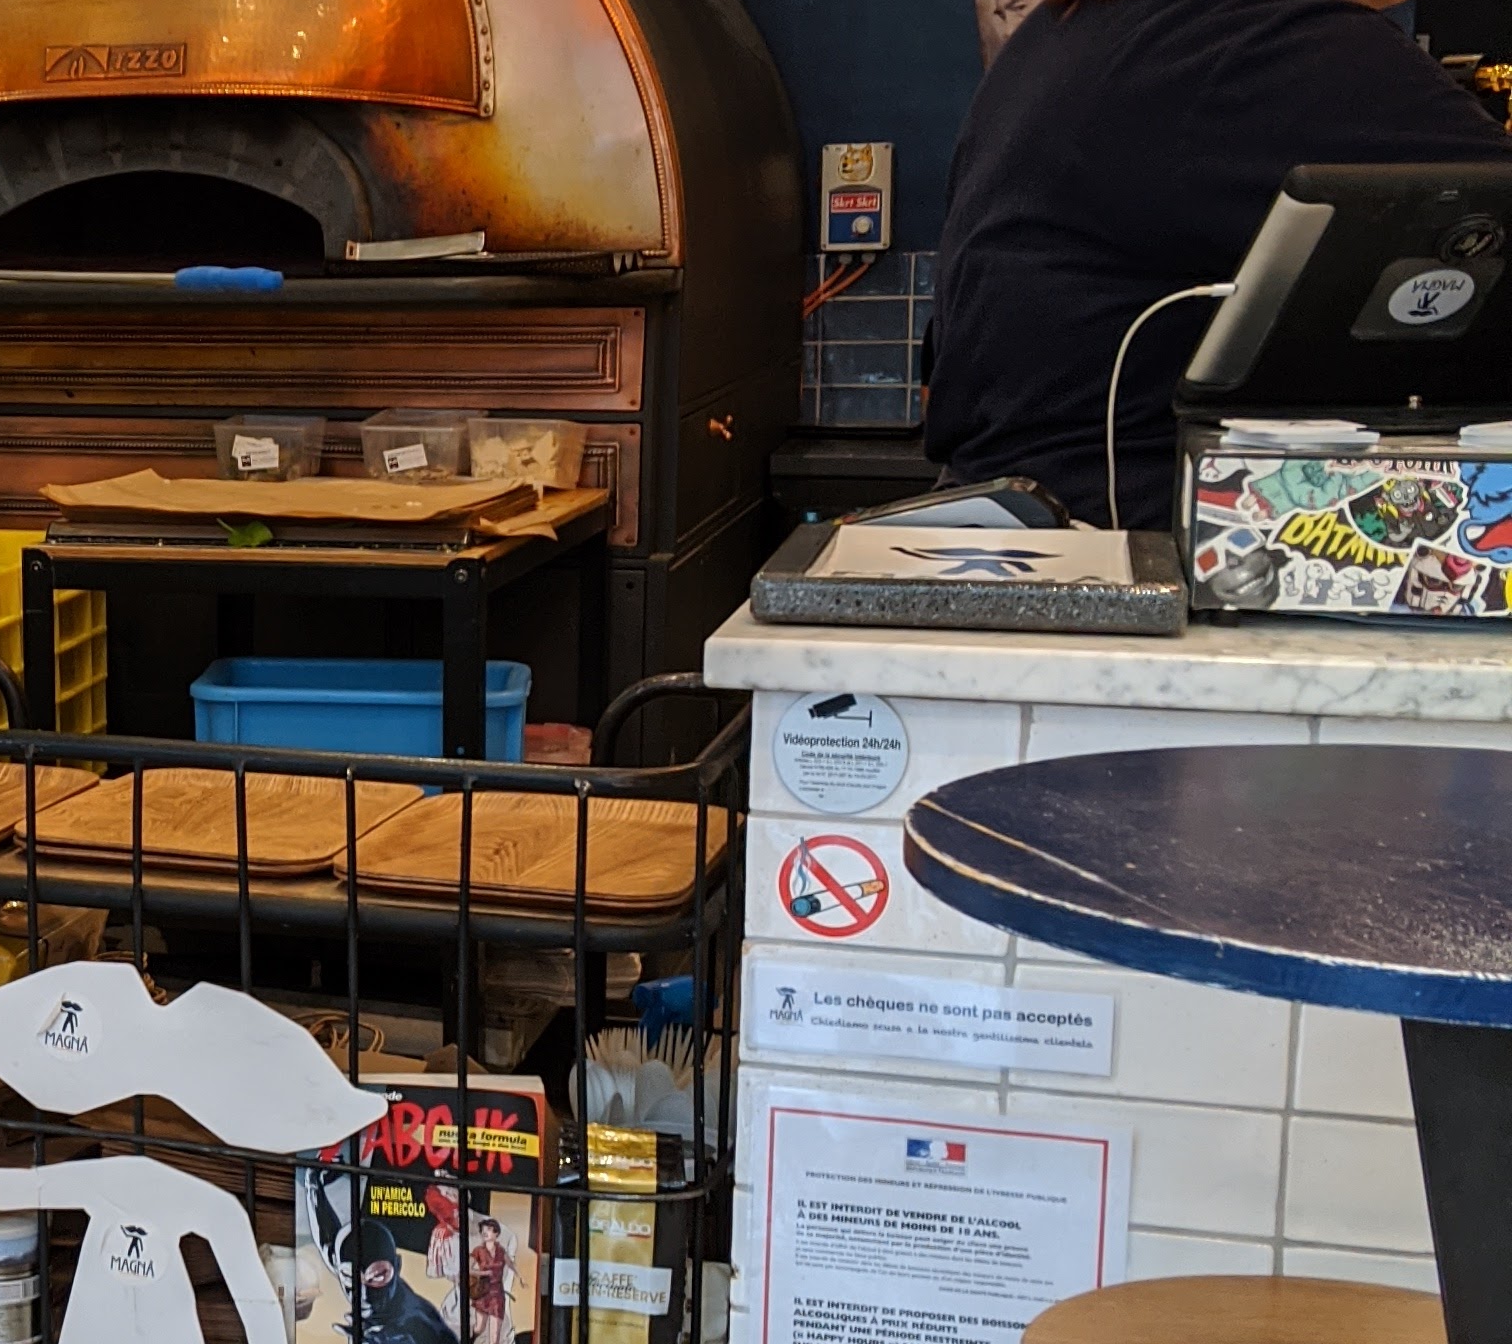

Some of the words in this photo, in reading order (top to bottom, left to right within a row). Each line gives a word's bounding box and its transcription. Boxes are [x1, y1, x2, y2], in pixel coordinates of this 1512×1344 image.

[833, 196, 854, 208] Skrt
[856, 196, 877, 207] Skrt
[783, 733, 860, 749] Vidéoprotection
[862, 736, 901, 750] 24h/24h
[814, 992, 842, 1005] Les
[846, 995, 914, 1012] chèques
[919, 1002, 938, 1014] ne
[943, 1005, 978, 1018] sont
[982, 1010, 1012, 1022] pas
[1016, 1012, 1093, 1027] acceptés
[480, 1130, 528, 1146] formula
[370, 1186, 412, 1202] UN'AMICA
[806, 1171, 857, 1182] PROTECTION
[858, 1175, 873, 1184] DES
[875, 1177, 910, 1188] MINEURS
[1026, 1193, 1067, 1204] PUBLIQUE
[370, 1202, 380, 1215] IN
[382, 1202, 426, 1218] PERICOLO
[798, 1199, 807, 1208] IL
[809, 1200, 828, 1210] EST
[831, 1202, 882, 1216] INTERDIT
[886, 1208, 900, 1217] DE
[903, 1210, 947, 1222] VENDRE
[951, 1214, 965, 1224] DE
[968, 1216, 1022, 1230] L'ALCOOL
[590, 1218, 652, 1236] ORALDO
[809, 1212, 828, 1222] DES
[831, 1214, 880, 1227] MINEURS
[884, 1219, 898, 1229] DE
[901, 1221, 937, 1233] MOINS
[940, 1224, 954, 1234] DE
[959, 1227, 970, 1236] 18
[974, 1228, 1000, 1239] ANS.
[793, 1297, 803, 1305] IL
[806, 1298, 824, 1308] EST
[827, 1300, 878, 1314] INTERDIT
[882, 1307, 896, 1315] DE
[899, 1309, 956, 1322] PROPOSER
[959, 1315, 978, 1325] DES
[794, 1308, 867, 1323] ALCOOLIQUES
[882, 1318, 908, 1329] PRIX
[912, 1321, 958, 1334] RÉDUITS
[793, 1319, 846, 1332] PENDANT
[849, 1325, 872, 1335] UNE
[875, 1328, 921, 1341] PÉRIODE
[807, 1332, 844, 1343] HAPPY
